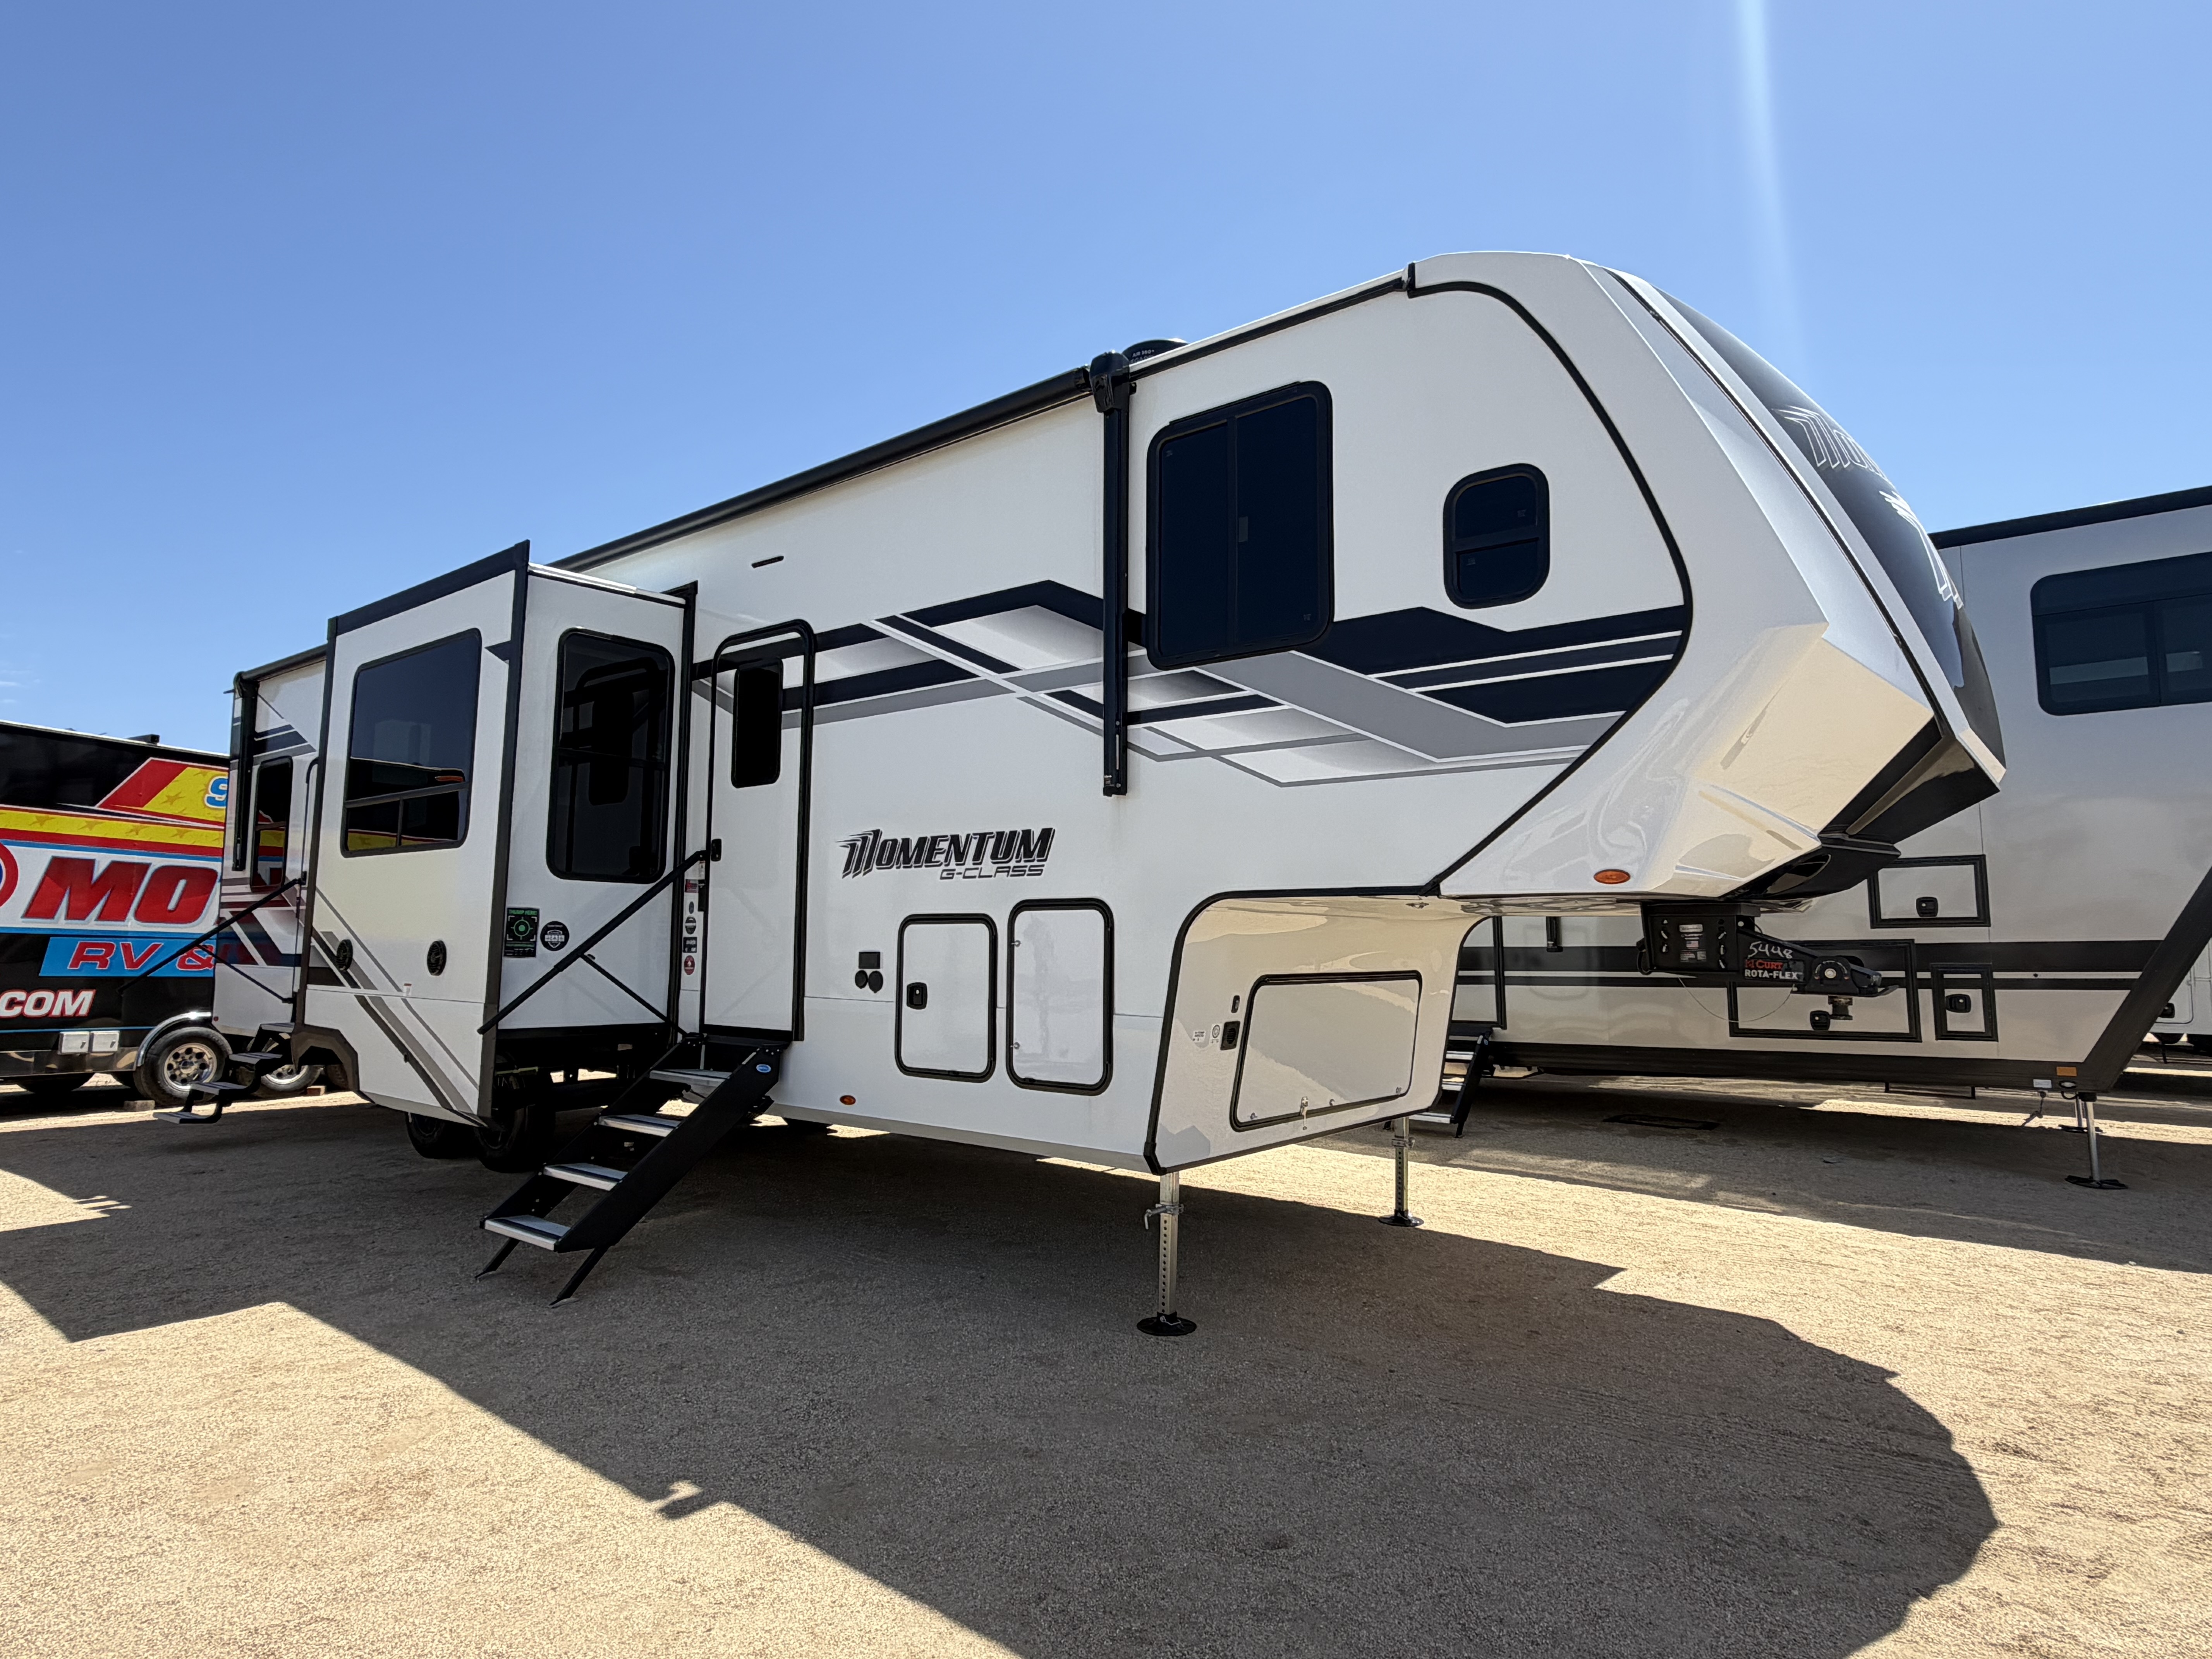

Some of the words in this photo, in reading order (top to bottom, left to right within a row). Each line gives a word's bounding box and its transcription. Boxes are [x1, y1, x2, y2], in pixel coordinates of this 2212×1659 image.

[835, 828, 1055, 879] MOMENTUM
[939, 865, 1045, 880] G-CLASS
[21, 855, 219, 926] MO
[67, 941, 164, 970] RV
[176, 944, 216, 971] &
[1756, 960, 1784, 969] CURT
[1744, 969, 1798, 980] ROTA-FLEX
